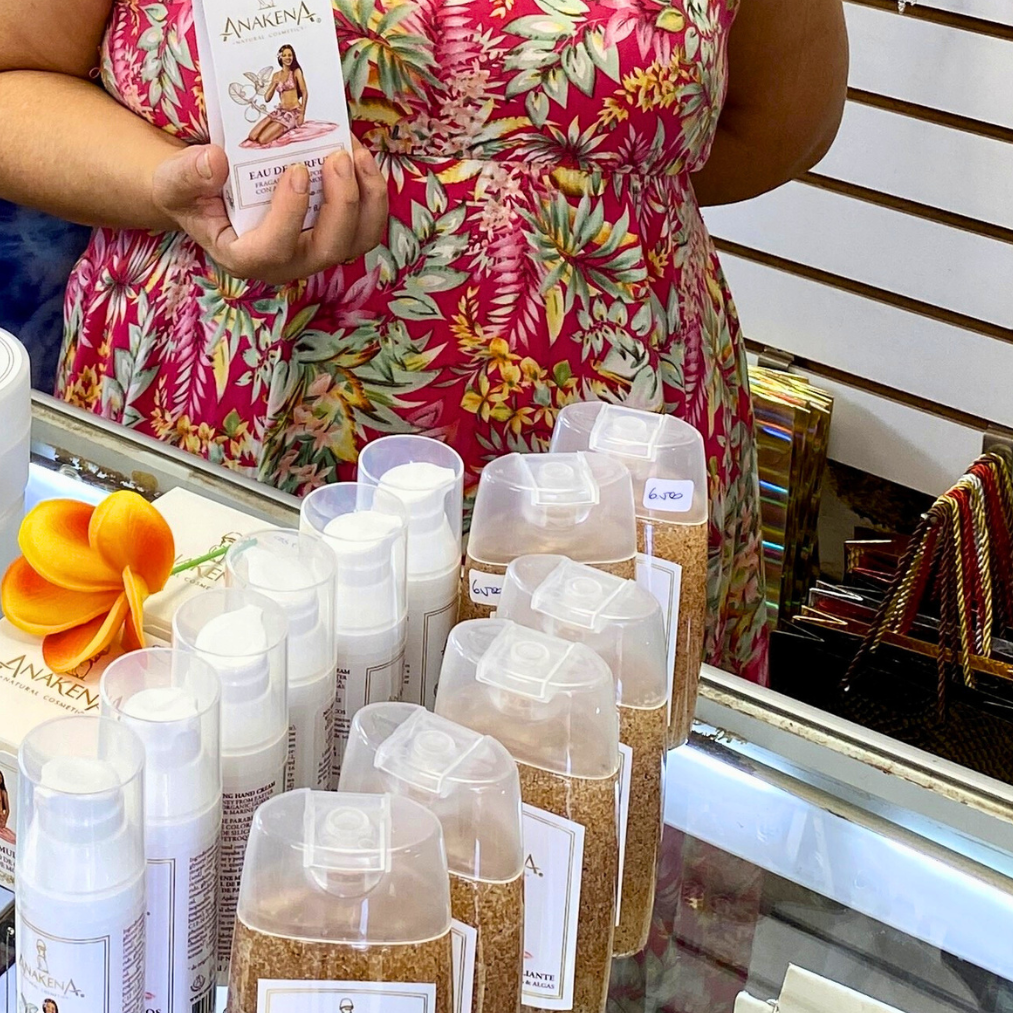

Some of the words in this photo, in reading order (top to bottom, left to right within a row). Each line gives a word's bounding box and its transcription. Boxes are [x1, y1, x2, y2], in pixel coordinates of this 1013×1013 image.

[219, 0, 316, 42] ANAKENA
[249, 168, 271, 180] EAU
[255, 186, 269, 195] CON
[3, 676, 39, 697] NATURAL
[235, 791, 256, 799] HAND
[256, 781, 276, 795] CREAM
[533, 981, 555, 990] ALGAS
